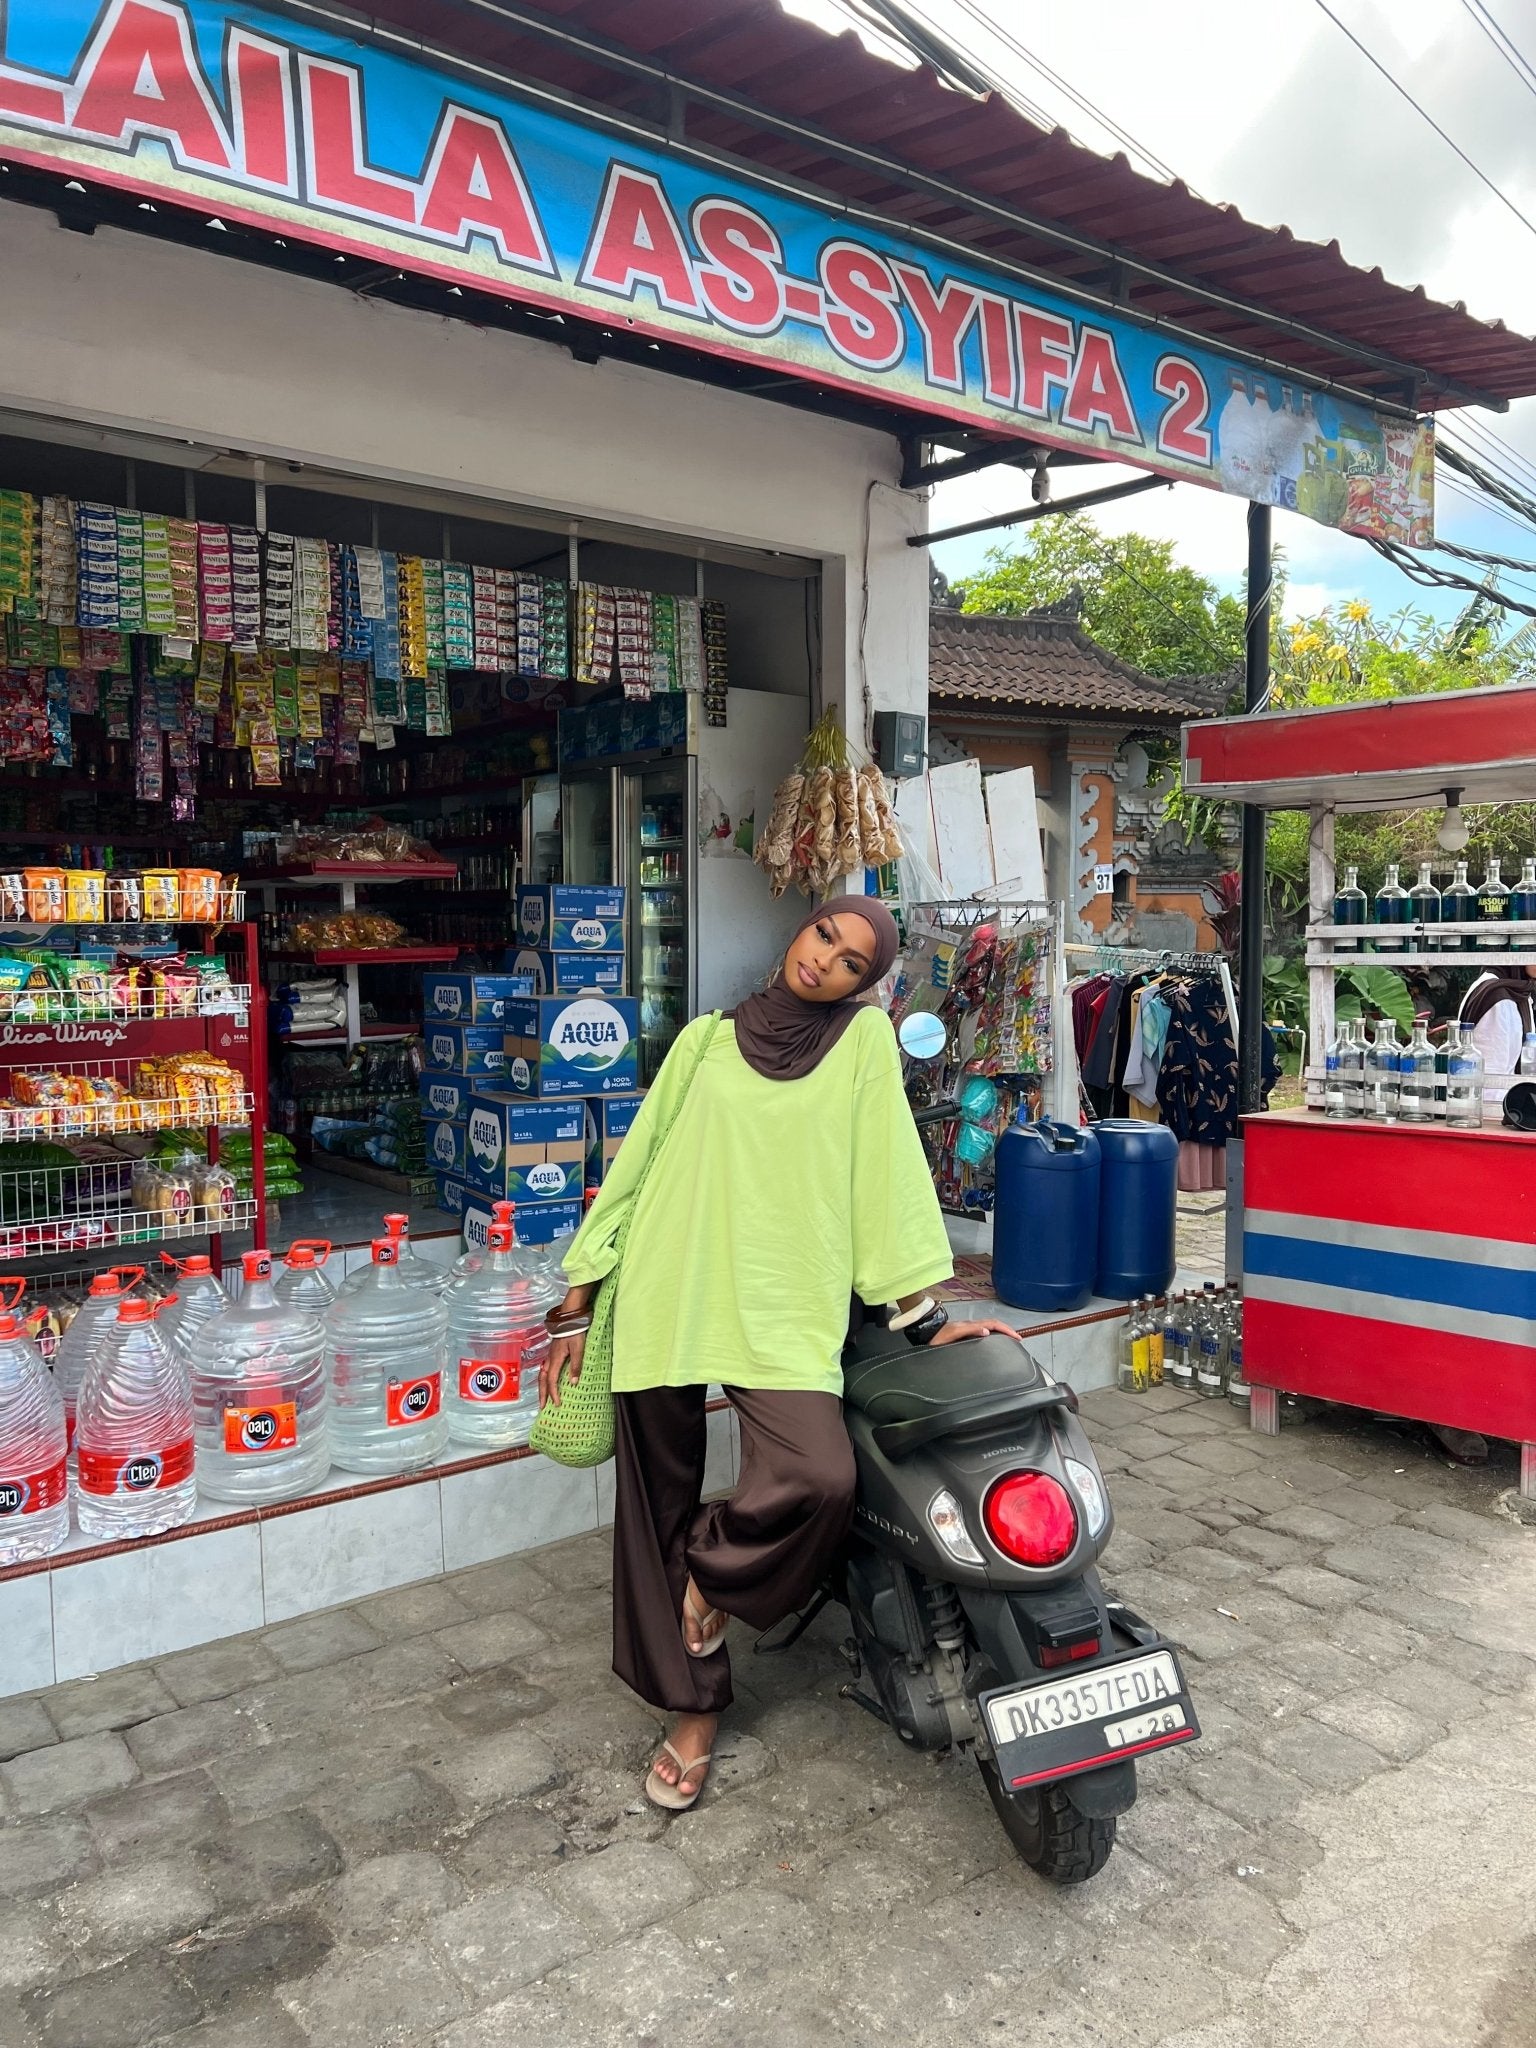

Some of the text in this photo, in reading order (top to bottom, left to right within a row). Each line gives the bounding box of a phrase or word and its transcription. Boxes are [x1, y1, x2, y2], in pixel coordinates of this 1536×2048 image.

[580, 162, 1144, 446] AS-SYIFA
[1154, 353, 1212, 468] 2
[88, 521, 115, 530] PANTENE
[89, 541, 116, 550] PANTENE
[203, 535, 227, 544] PANTENE
[204, 555, 228, 563] PANTENE
[90, 562, 115, 571] PANTENE
[145, 572, 169, 580] PANTENE
[205, 575, 229, 583] PANTENE
[90, 583, 116, 592] PANTENE
[147, 592, 171, 600] PANTENE
[206, 595, 230, 603] PANTENE
[91, 604, 118, 614] PANTENE
[149, 612, 173, 620] PANTENE
[208, 615, 232, 623] PANTENE
[1097, 873, 1110, 891] 37
[524, 901, 541, 924] AQUA
[1484, 904, 1503, 913] LIME
[576, 926, 602, 938] AQUA
[437, 989, 459, 1007] AQUA
[54, 1023, 127, 1047] Wings
[560, 1021, 619, 1047] AQUA
[435, 1038, 452, 1057] AQUA
[514, 1066, 528, 1078] AQUA
[433, 1088, 455, 1108] AQUA
[473, 1120, 498, 1148] AQUA
[437, 1137, 453, 1156] AQUA
[532, 1172, 561, 1185] AQUA
[468, 1219, 489, 1247] AQU
[477, 1374, 497, 1388] Cleo
[408, 1391, 426, 1405] Cleo
[247, 1420, 272, 1435] Cleo
[983, 1445, 1025, 1460] HONDA
[130, 1465, 157, 1483] Cleo
[1007, 1666, 1170, 1740] DK3357FDA
